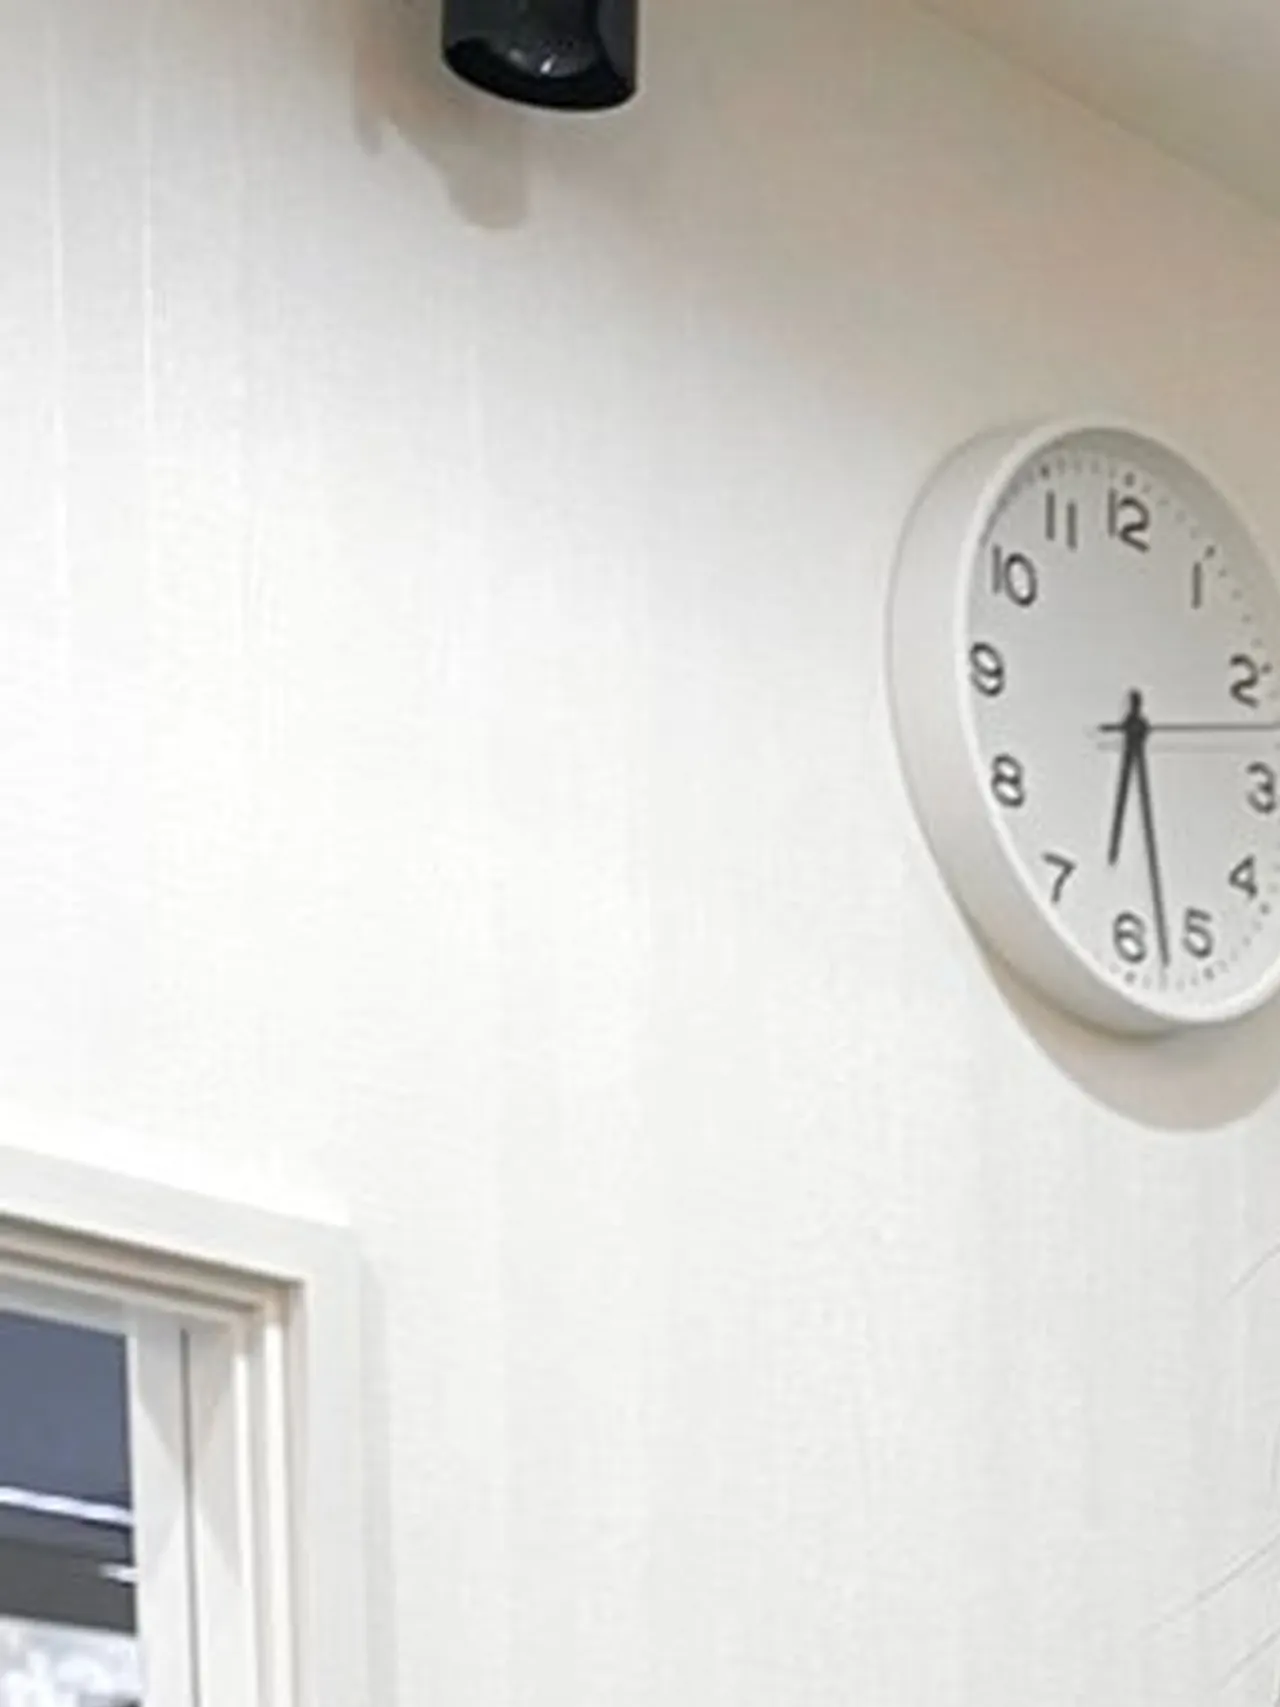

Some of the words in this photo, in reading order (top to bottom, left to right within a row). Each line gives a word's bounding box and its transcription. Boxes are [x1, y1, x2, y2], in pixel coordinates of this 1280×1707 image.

[1045, 490, 1078, 551] 11
[1108, 489, 1150, 553] 12
[993, 545, 1038, 607] 10
[1191, 562, 1203, 610] 1
[969, 641, 1005, 697] 9
[1229, 654, 1260, 707] 2
[990, 753, 1025, 808] 8
[1246, 762, 1278, 814] 3
[1042, 852, 1076, 905] 7
[1228, 856, 1258, 899] 4
[1113, 912, 1147, 964] 6
[1184, 907, 1216, 960] 5
